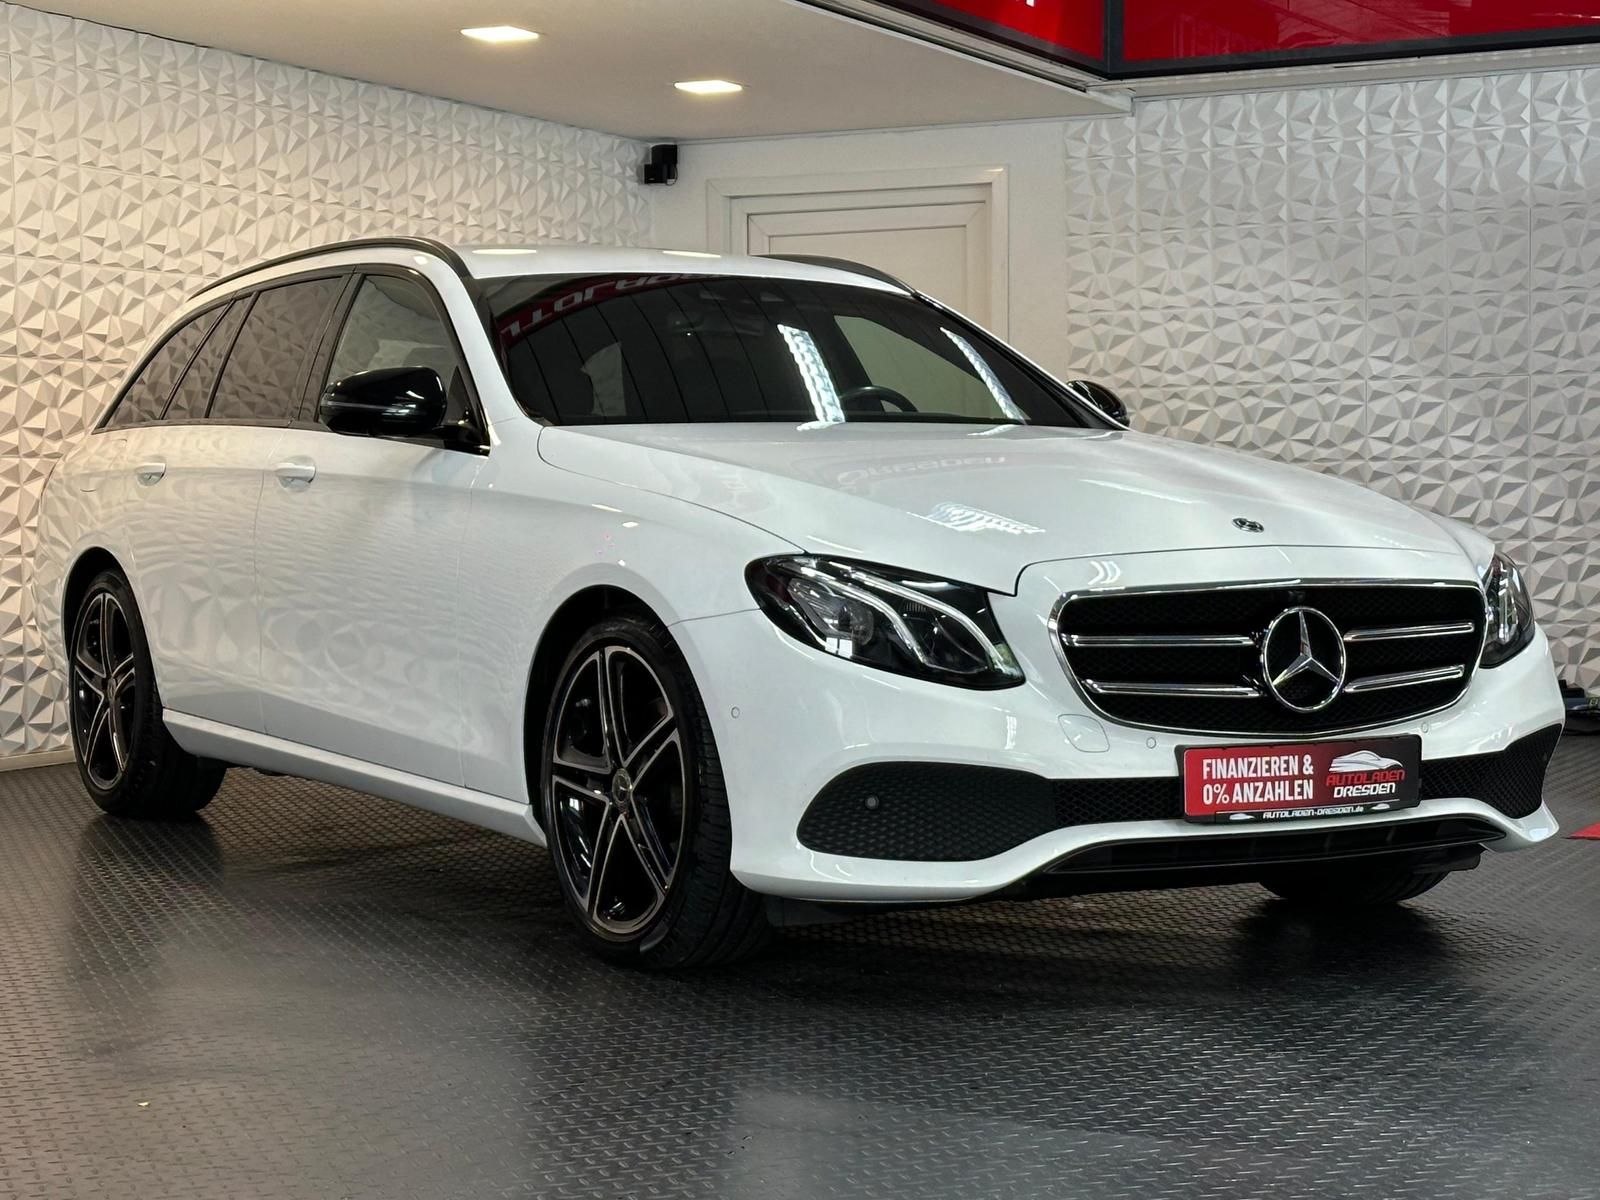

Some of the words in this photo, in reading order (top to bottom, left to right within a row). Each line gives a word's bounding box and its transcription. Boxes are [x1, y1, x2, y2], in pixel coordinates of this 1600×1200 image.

[1203, 755, 1299, 779] FINANZIEREN
[1303, 754, 1314, 775] &
[1326, 769, 1406, 787] AUTOLADEN
[1203, 783, 1230, 805] 0%
[1232, 779, 1314, 803] ANZAHLEN
[1333, 782, 1396, 798] DRESDEN
